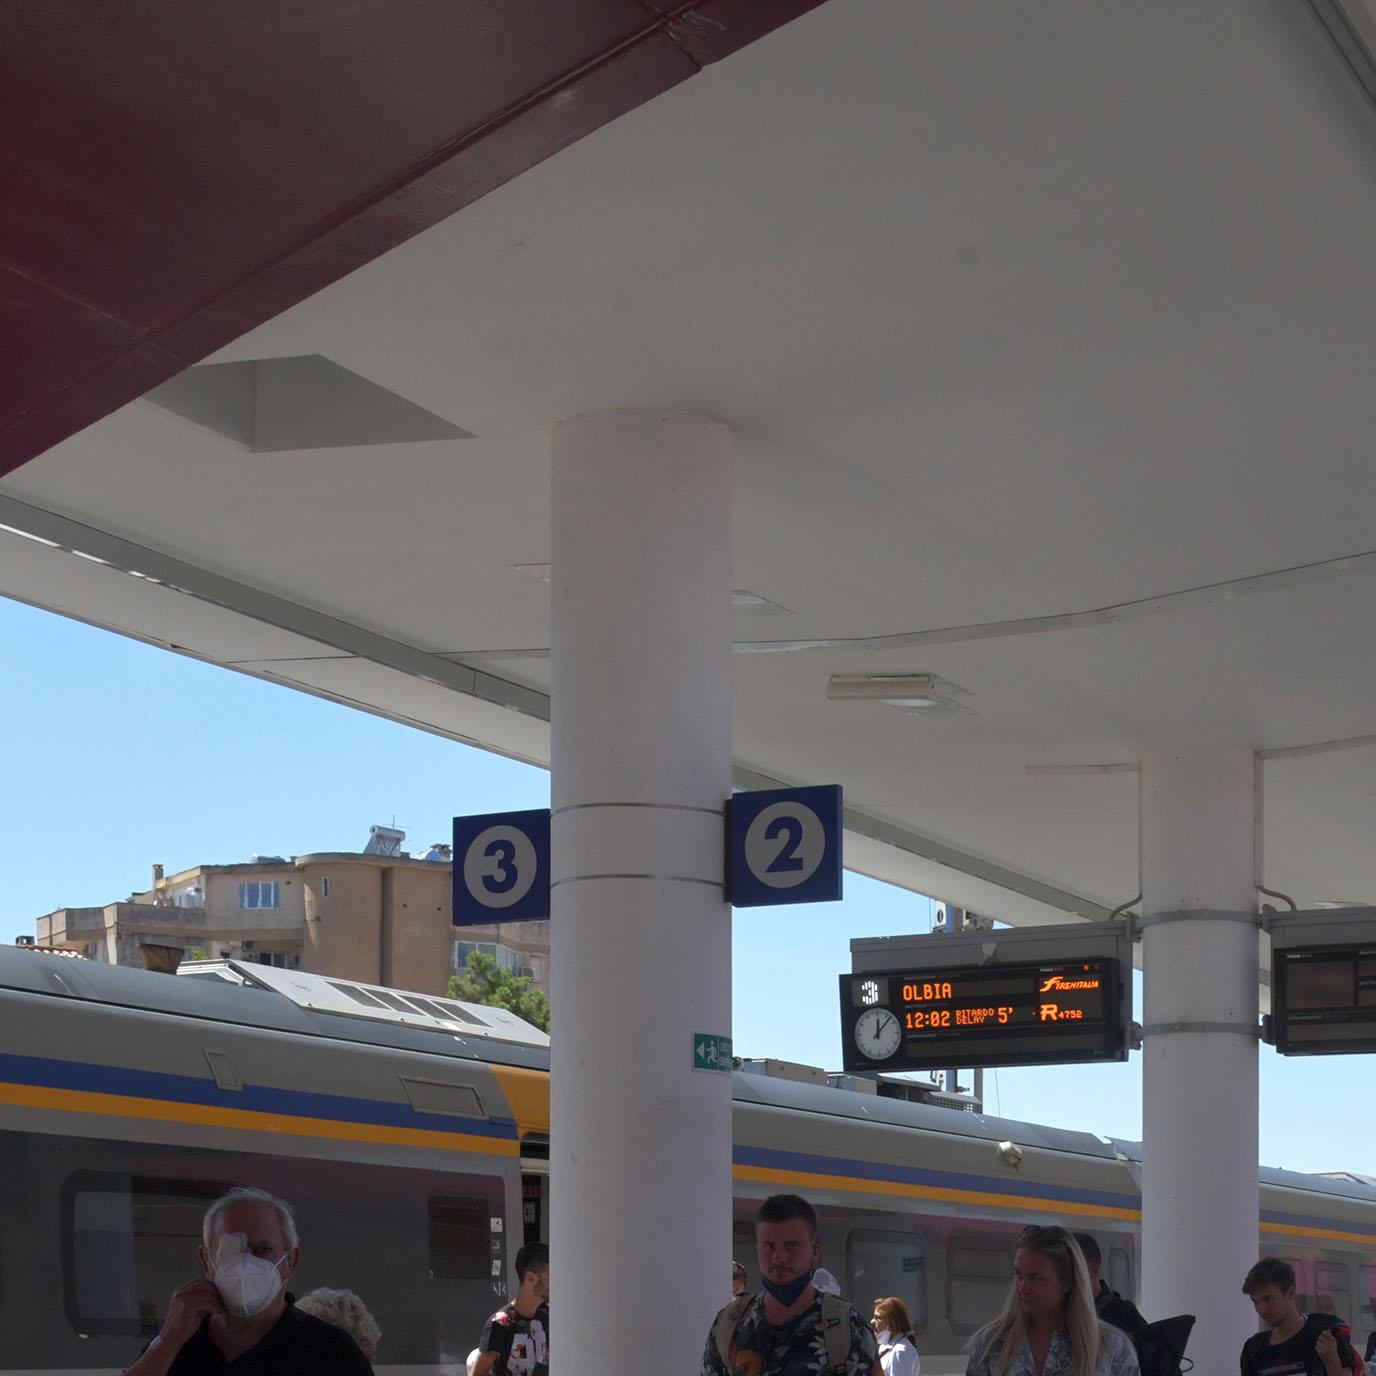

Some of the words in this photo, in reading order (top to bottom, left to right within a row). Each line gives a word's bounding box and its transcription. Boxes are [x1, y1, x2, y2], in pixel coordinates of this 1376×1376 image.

[763, 815, 805, 874] 2
[481, 839, 519, 895] 3
[861, 980, 878, 1005] 3
[902, 982, 952, 1002] OLBIA
[905, 1010, 951, 1029] 12:02
[956, 1008, 994, 1018] RITARDO
[956, 1015, 985, 1025] DELAY
